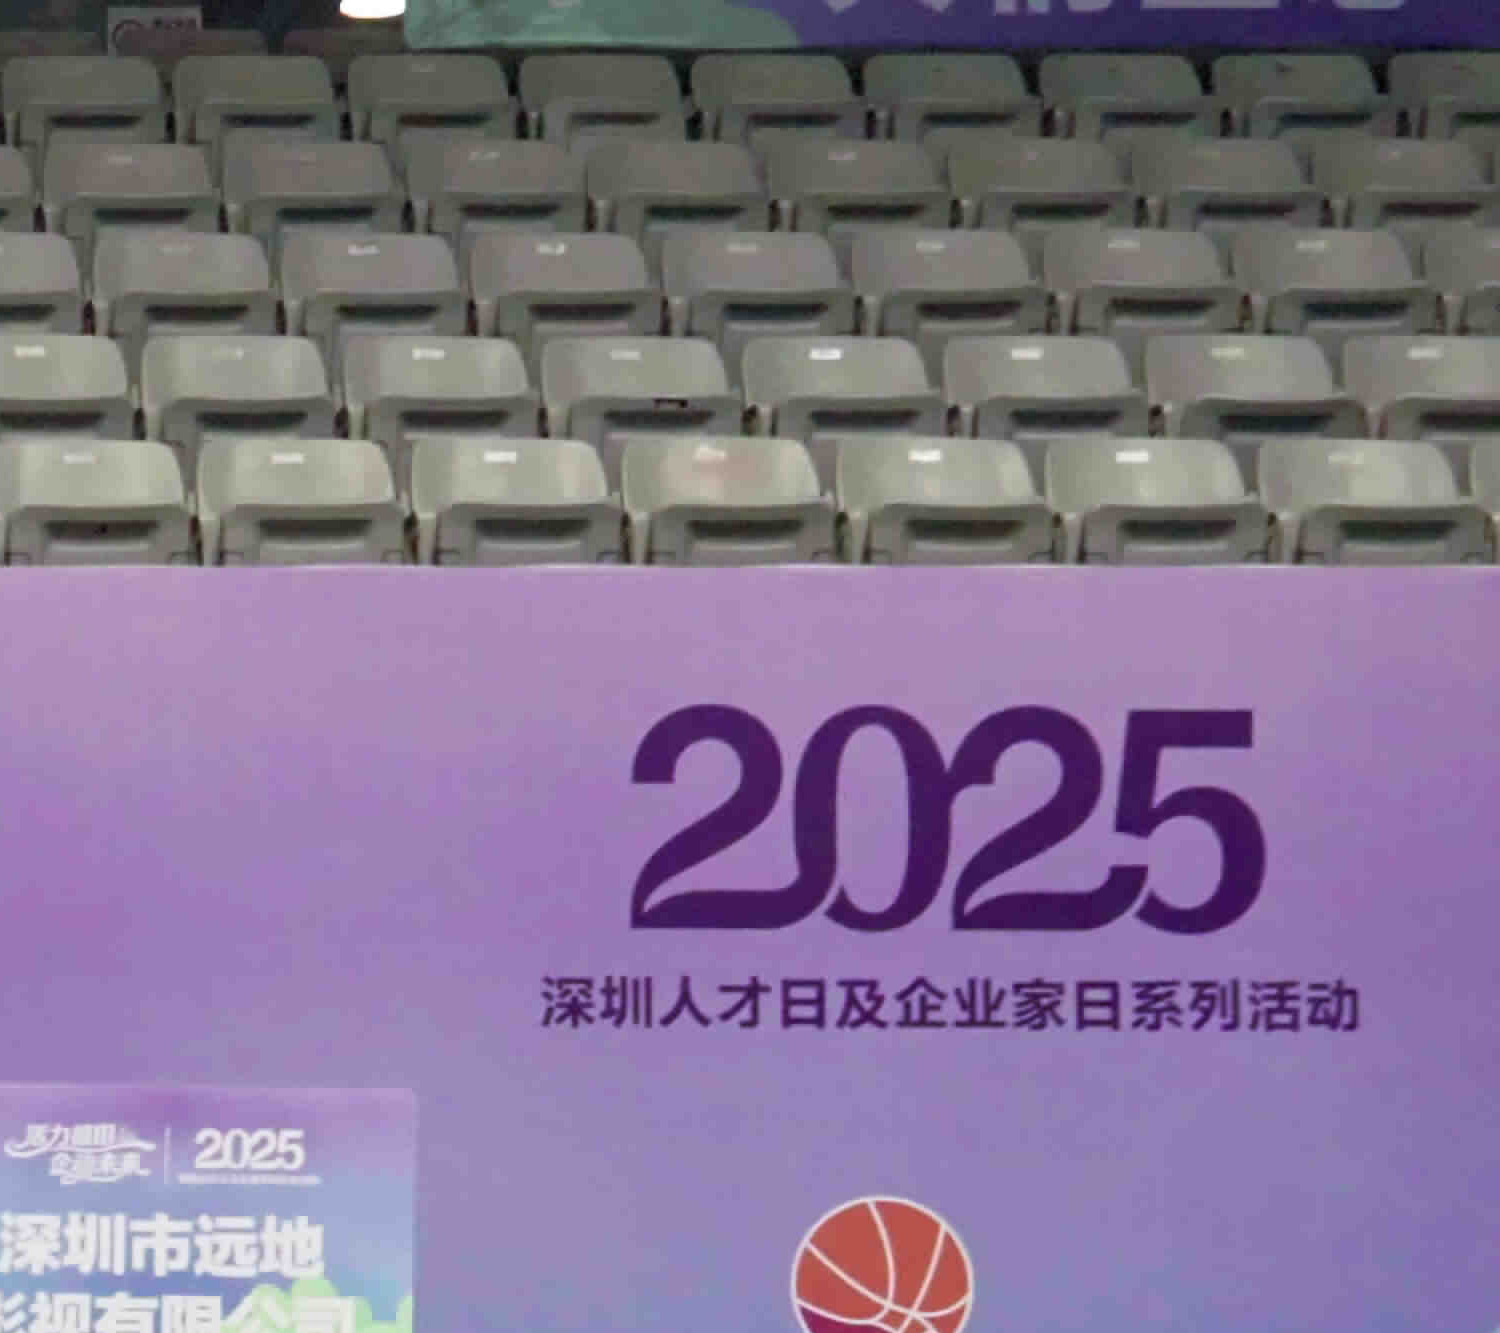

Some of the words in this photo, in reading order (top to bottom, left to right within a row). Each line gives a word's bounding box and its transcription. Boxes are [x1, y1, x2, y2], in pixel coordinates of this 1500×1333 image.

[630, 703, 1266, 934] 2025
[540, 975, 1360, 1033] 深圳人才日及企业家日系列活动
[195, 1128, 307, 1171] 2025
